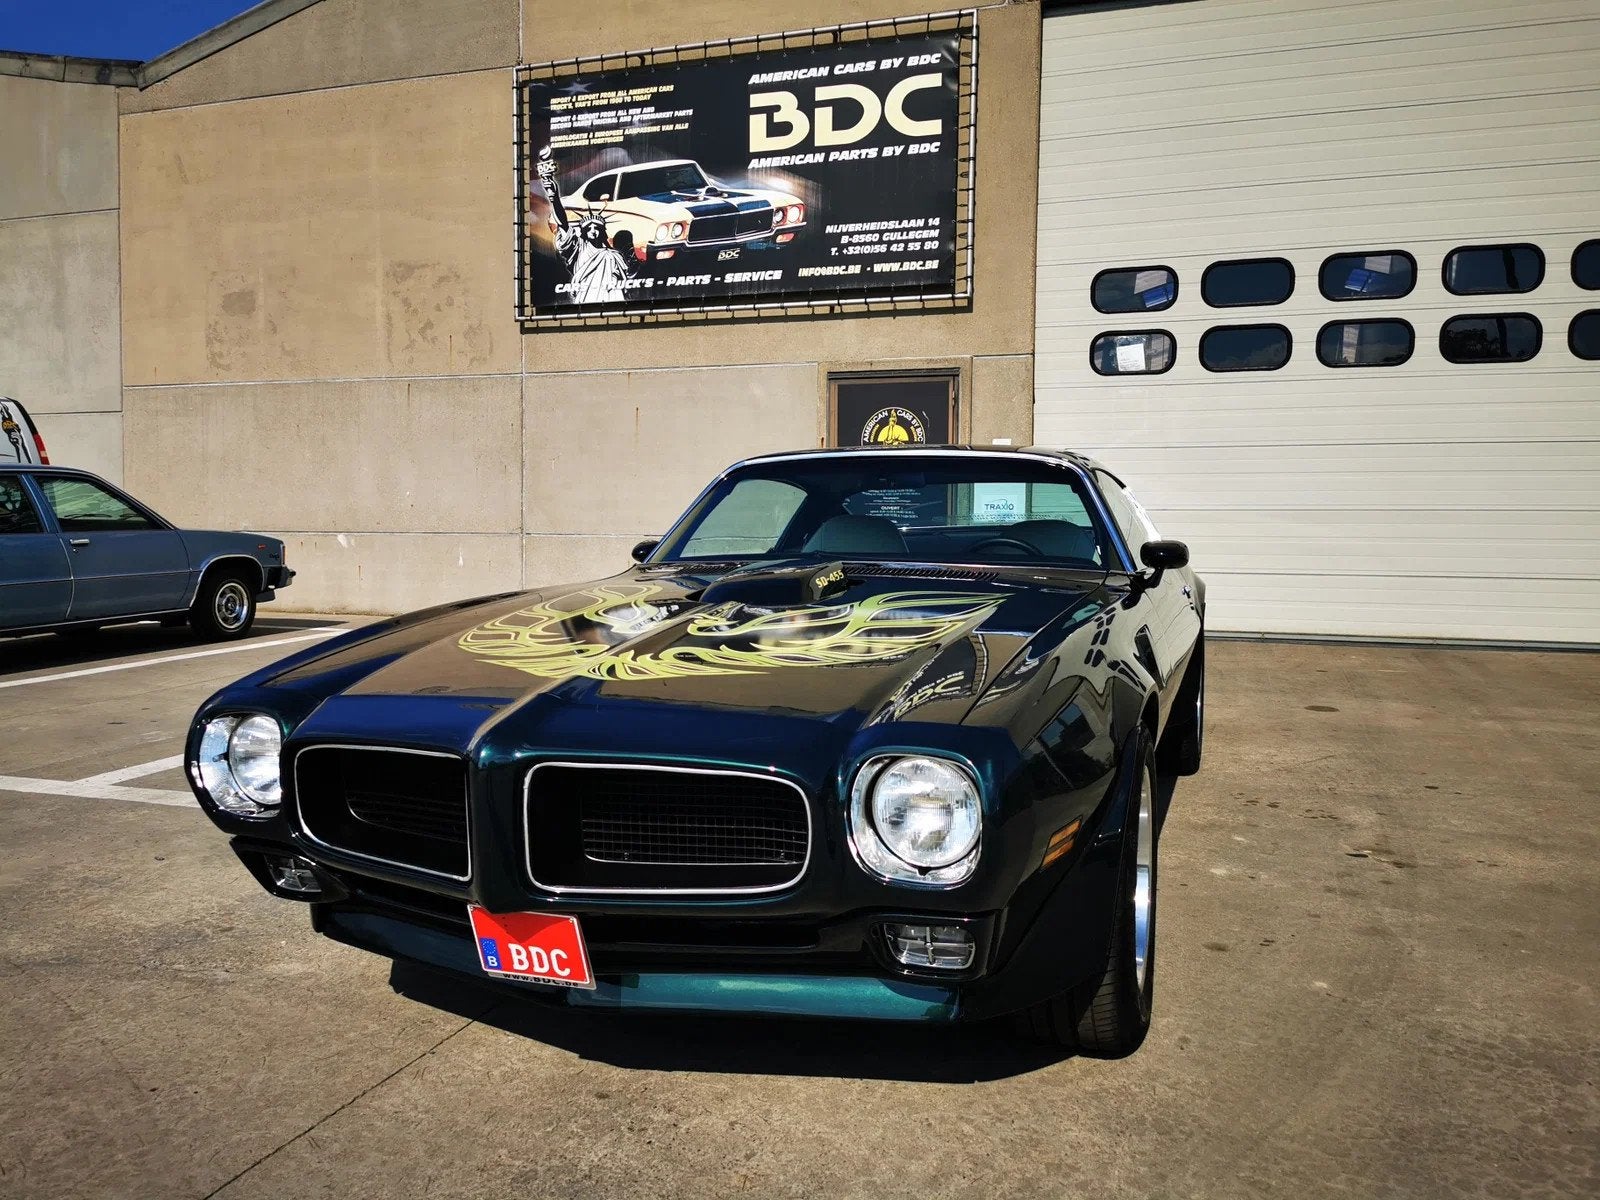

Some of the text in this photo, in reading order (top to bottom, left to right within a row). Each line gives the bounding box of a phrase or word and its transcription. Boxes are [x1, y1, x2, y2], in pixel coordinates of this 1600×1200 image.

[748, 53, 941, 84] AMERICAN CARS BY BDC
[577, 93, 599, 101] EXPORT
[628, 86, 657, 95] AMERICAN
[592, 98, 608, 106] FROM
[674, 109, 693, 117] PARTS
[749, 72, 943, 153] BDC
[661, 123, 674, 131] VAN
[674, 122, 689, 130] ALLE
[748, 142, 941, 169] AMERICAN PARTS BY BDC
[825, 217, 940, 233] NIJVERHEIDSLAAN 14
[840, 233, 880, 244] B-8560
[718, 250, 741, 260] BDC
[830, 240, 939, 256] T. +32(0)56 42 55 80
[798, 265, 862, 277] INFO@BDC.BE
[873, 260, 940, 273] WWW.BDC.BE
[666, 274, 712, 287] PARTS
[724, 270, 783, 284] SERVICE
[896, 409, 913, 421] CARS
[863, 410, 889, 443] AMERICAN
[911, 418, 920, 428] BY
[915, 427, 924, 442] BDC
[984, 502, 1015, 511] TRAXIO
[815, 569, 845, 588] SD-455
[487, 943, 571, 977] B BDC
